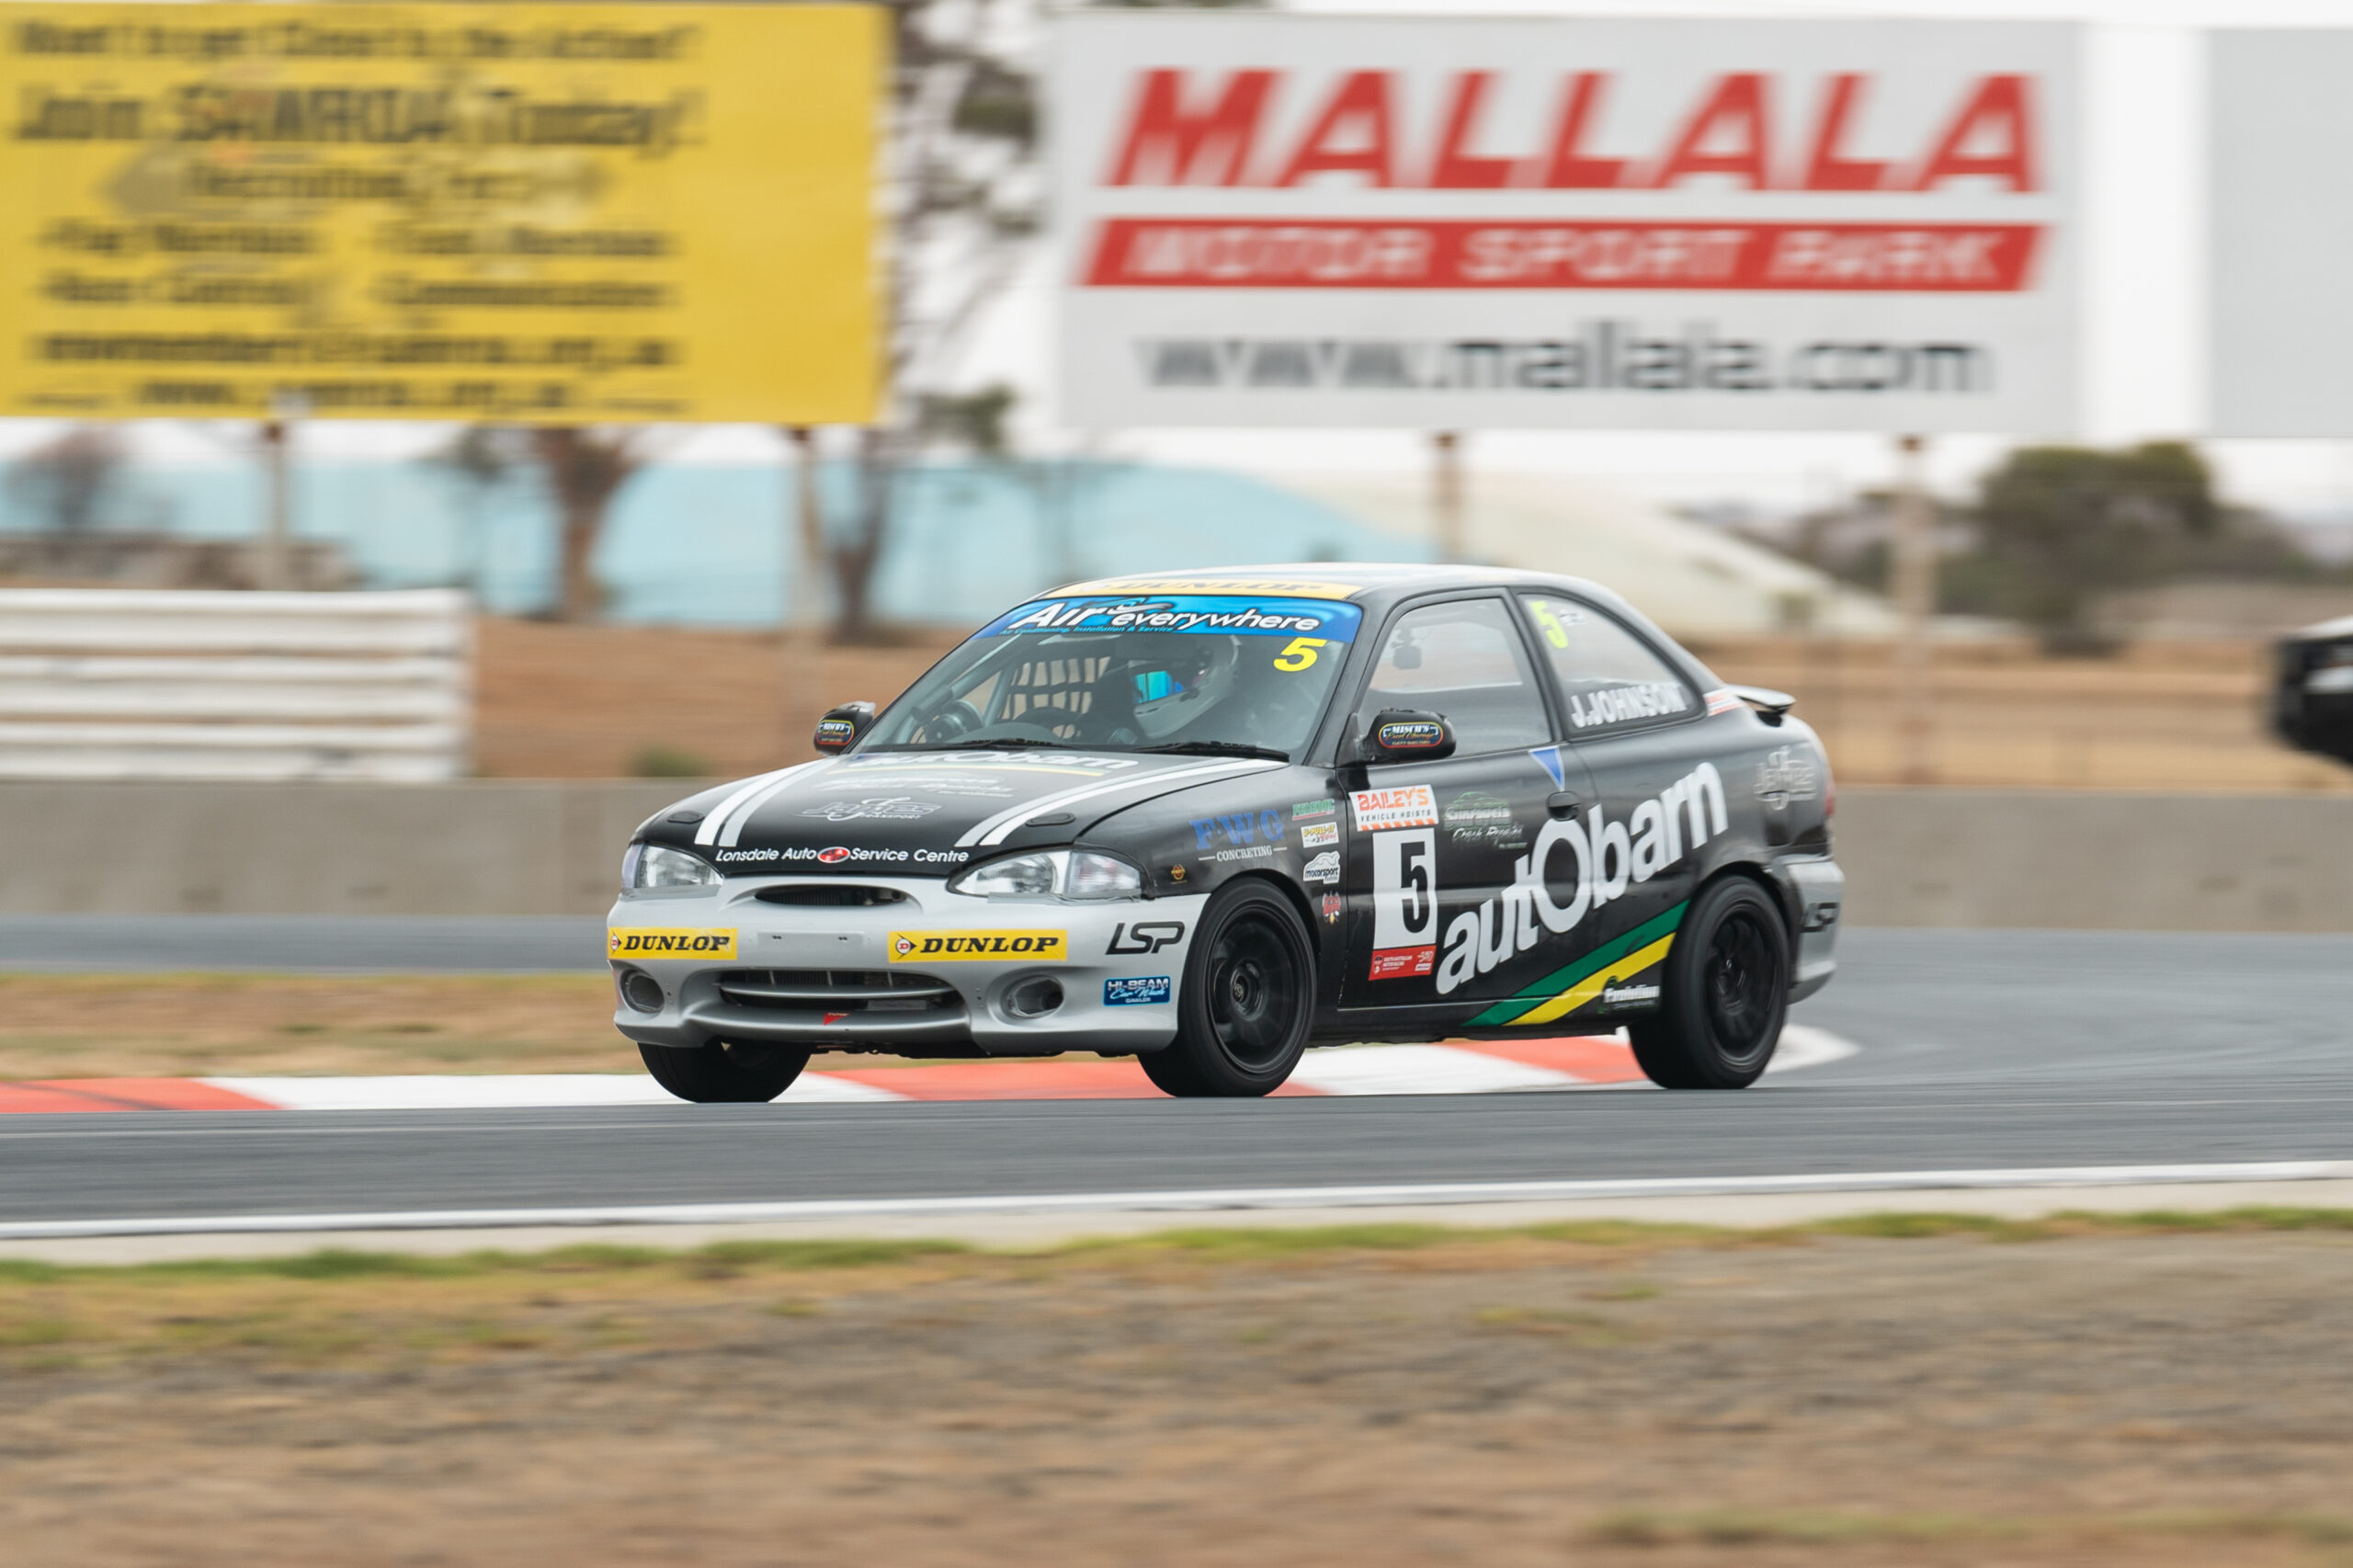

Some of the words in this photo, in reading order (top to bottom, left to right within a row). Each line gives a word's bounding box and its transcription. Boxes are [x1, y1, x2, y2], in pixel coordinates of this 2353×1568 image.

[1108, 66, 2044, 193] MALLALA
[1121, 225, 1434, 280] MOTOR
[1458, 229, 1752, 282] SPORT
[1768, 232, 2004, 284] PARK
[1138, 321, 1998, 393] www.mallala.com
[1007, 601, 1108, 630] Air
[1111, 608, 1322, 632] everywhere
[1529, 600, 1569, 648] 5
[1273, 637, 1327, 672] 5
[1357, 787, 1429, 812] BAILEY'S
[1361, 812, 1396, 823] VEHICLE
[1401, 809, 1432, 818] HOISTS
[715, 847, 779, 862] Lonsdale
[781, 847, 817, 861] Auto
[850, 847, 909, 861] Service
[913, 848, 970, 862] Centre
[1216, 846, 1273, 862] CONCRETING
[1400, 841, 1430, 933] 5
[623, 935, 731, 951] DUNLOP
[920, 937, 1060, 953] DUNLOP
[1105, 921, 1185, 955] LSP
[1108, 978, 1169, 991] HI-BEAM
